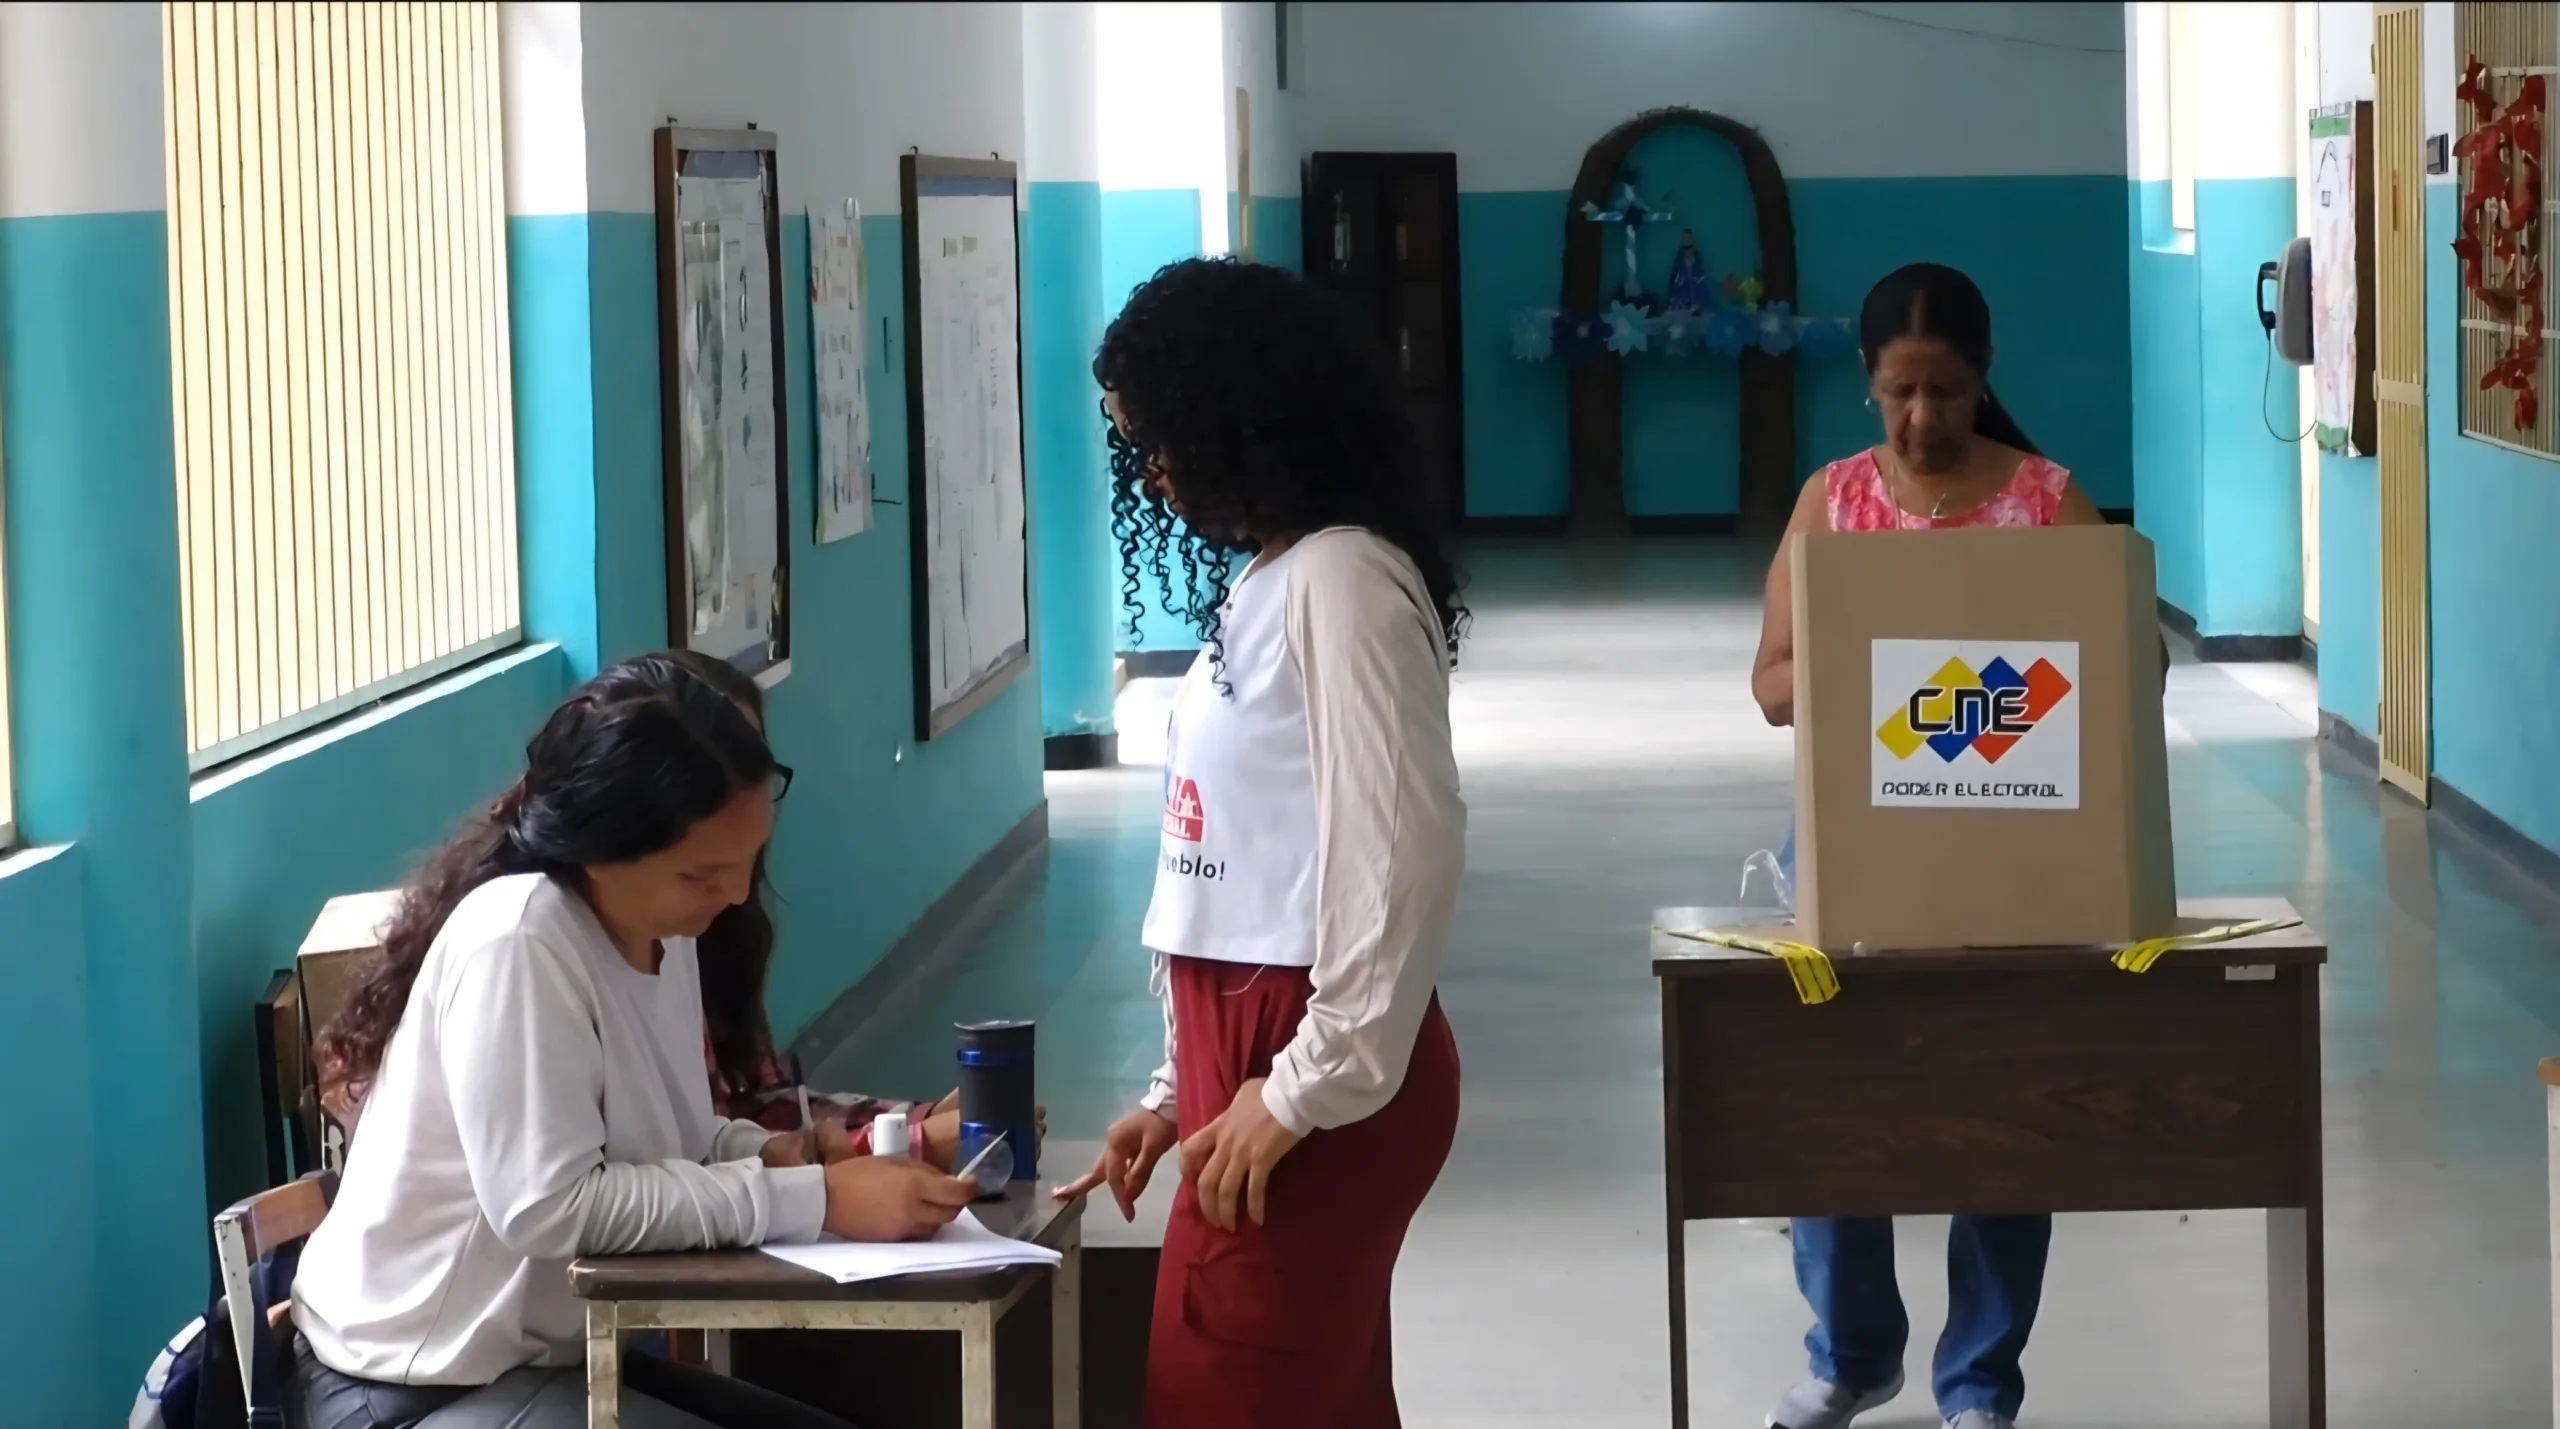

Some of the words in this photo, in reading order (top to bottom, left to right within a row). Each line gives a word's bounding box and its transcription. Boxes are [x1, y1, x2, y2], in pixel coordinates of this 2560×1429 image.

[1909, 687, 2035, 734] CNE
[1881, 781, 1949, 797] PODER
[1955, 782, 2064, 798] ELECTORAL
